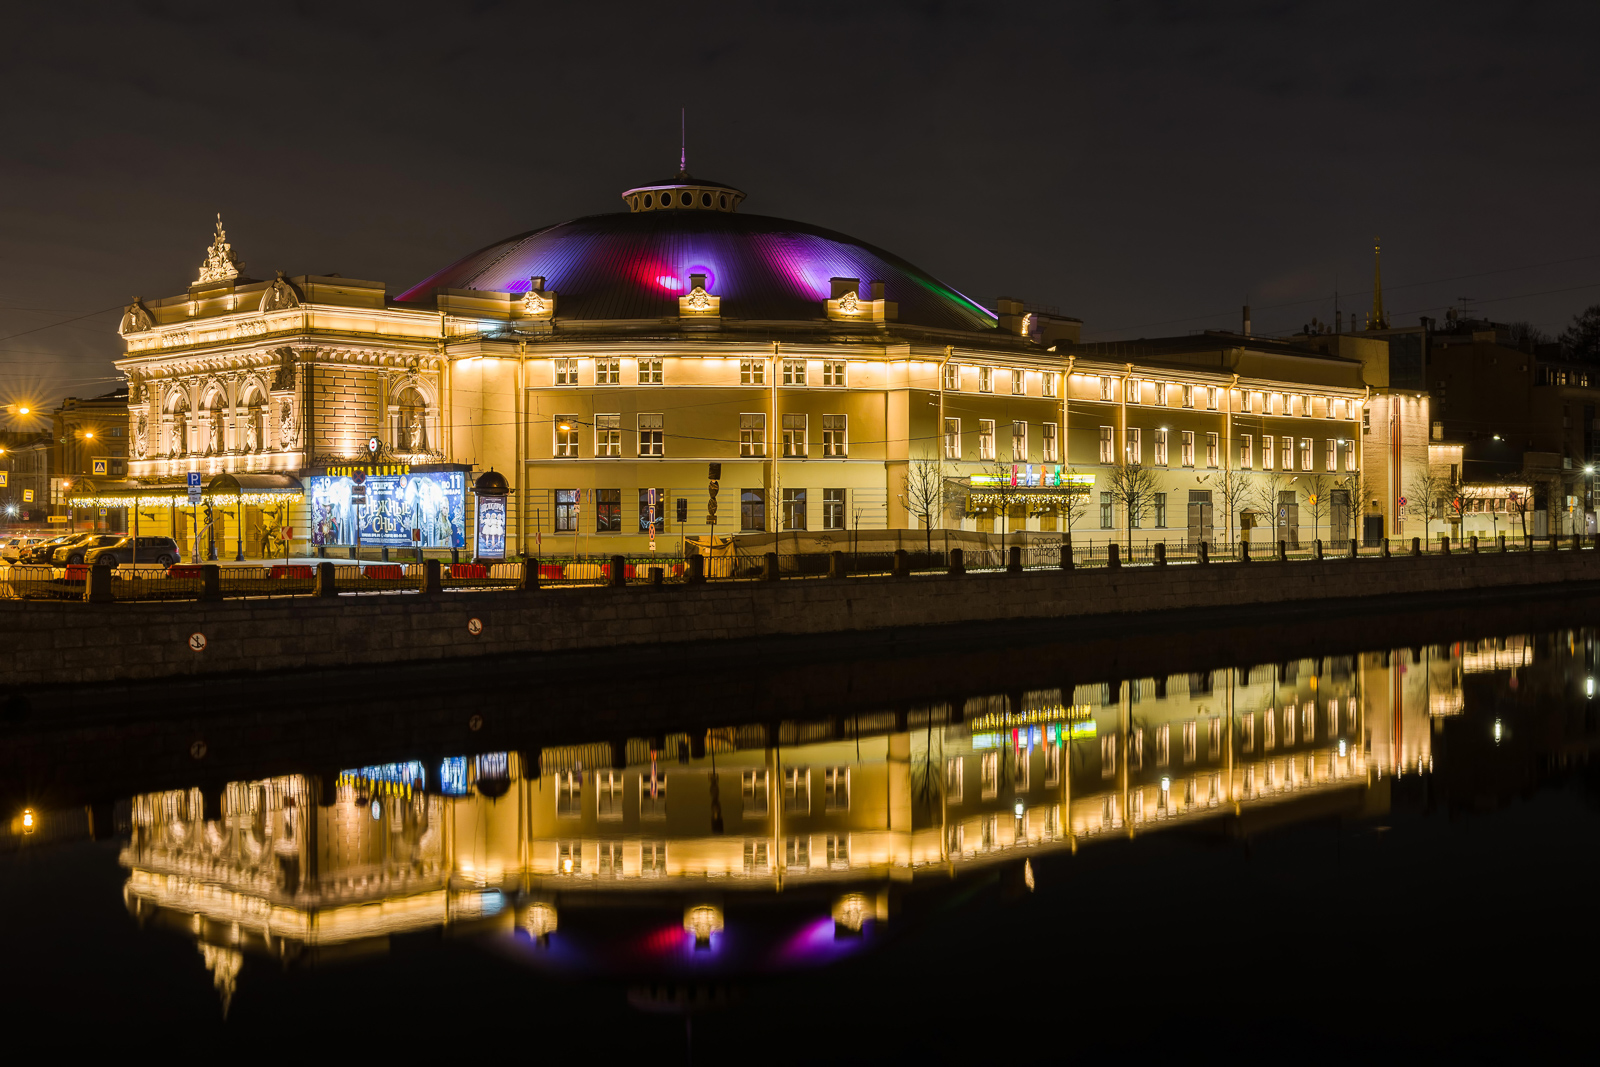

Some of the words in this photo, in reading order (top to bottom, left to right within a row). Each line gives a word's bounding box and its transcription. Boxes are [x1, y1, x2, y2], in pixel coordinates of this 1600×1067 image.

[376, 465, 410, 476] ЦИРКЕ
[191, 473, 199, 485] P
[320, 478, 331, 490] 19
[449, 474, 461, 488] 11
[359, 495, 411, 519] СНЕЖНЫЕ
[372, 515, 397, 533] СНЫ
